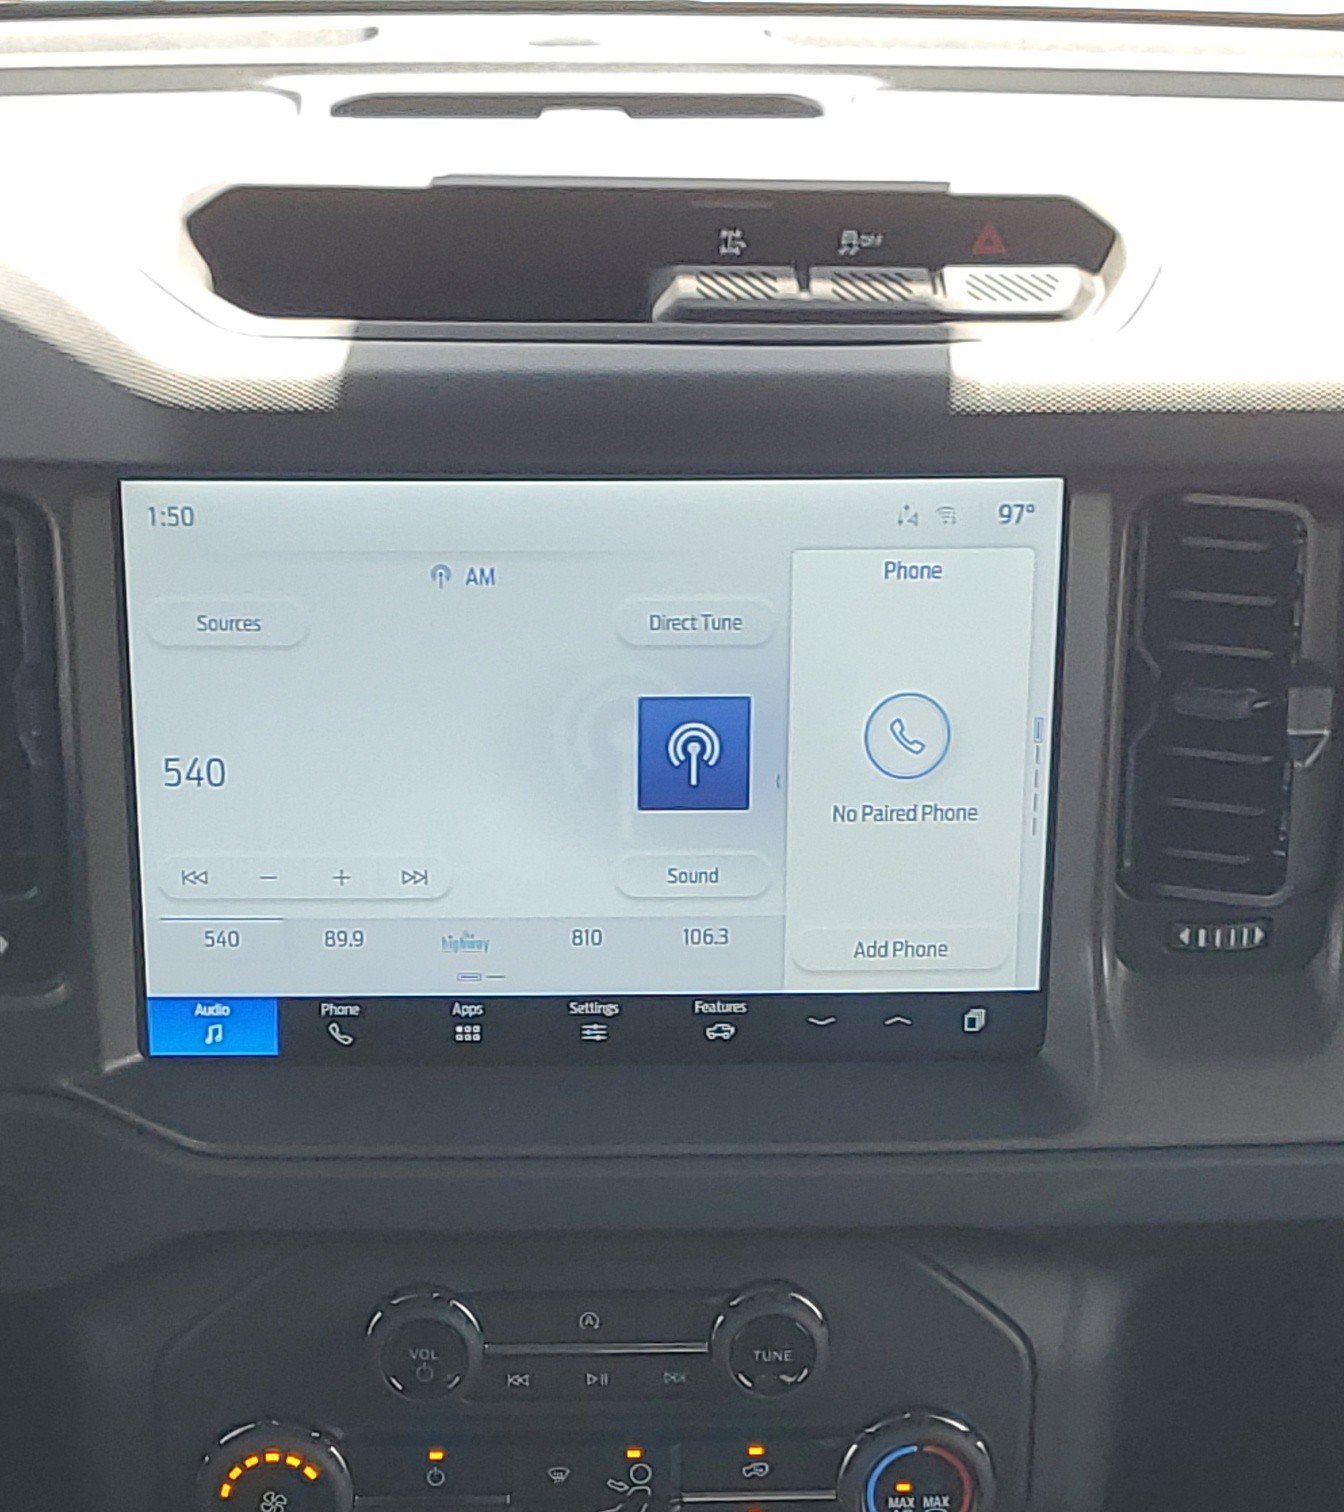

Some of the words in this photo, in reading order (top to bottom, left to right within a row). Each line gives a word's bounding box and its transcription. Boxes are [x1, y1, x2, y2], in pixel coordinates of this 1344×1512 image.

[147, 505, 194, 528] 1:50
[998, 504, 1035, 524] 97°
[465, 567, 496, 586] AM
[884, 561, 943, 580] Phone
[197, 614, 262, 632] Sources
[649, 614, 697, 631] Direct
[700, 614, 743, 631] Tune
[163, 757, 226, 788] 540
[832, 804, 857, 823] No
[861, 804, 917, 822] Paired
[921, 803, 978, 822] Phone
[667, 867, 719, 885] Sound
[204, 931, 240, 949] 540
[323, 930, 365, 948] 89.9
[572, 929, 603, 947] 810
[683, 929, 729, 946] 106.3
[854, 940, 888, 959] Add
[892, 940, 949, 958] Phone
[195, 1002, 231, 1016] Audio
[321, 1002, 361, 1017] Phone
[452, 1003, 485, 1019] Apps
[569, 1001, 620, 1017] Settings
[694, 1001, 748, 1015] Features
[409, 1348, 438, 1360] VOL
[753, 1350, 794, 1362] TUNE
[888, 1497, 915, 1509] MAX
[922, 1496, 950, 1508] MAX
